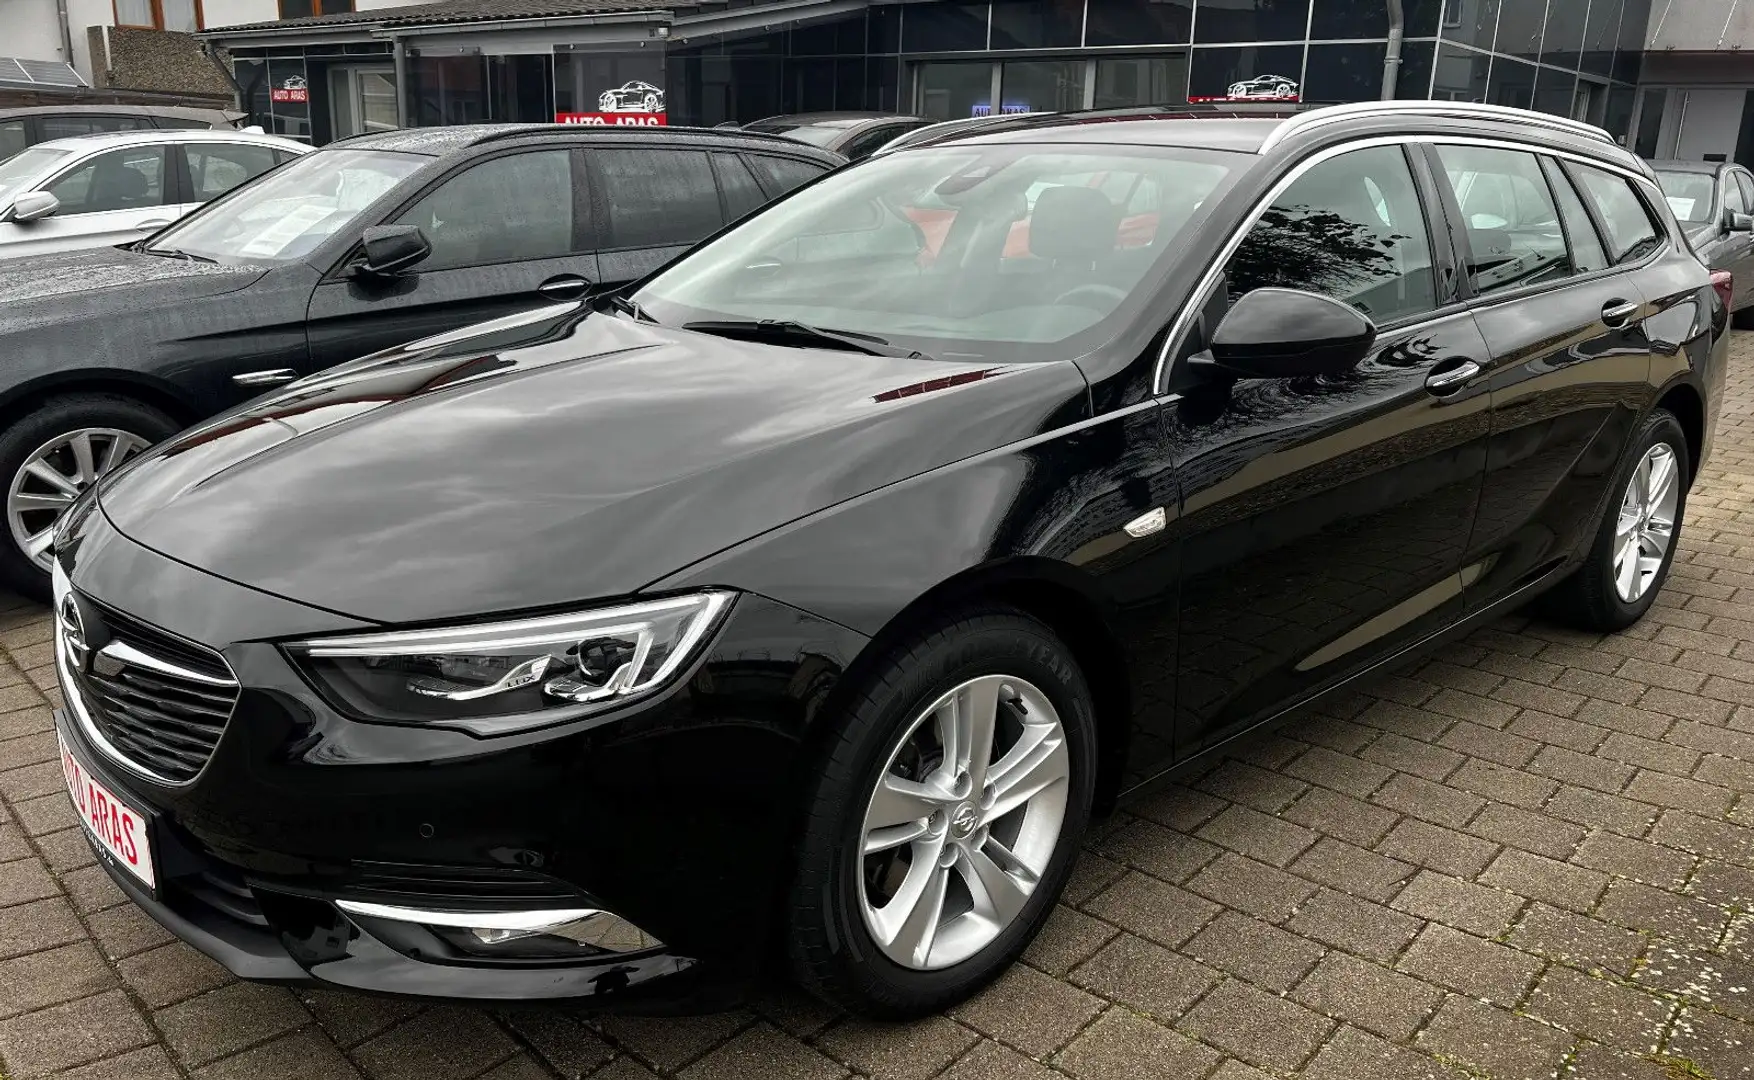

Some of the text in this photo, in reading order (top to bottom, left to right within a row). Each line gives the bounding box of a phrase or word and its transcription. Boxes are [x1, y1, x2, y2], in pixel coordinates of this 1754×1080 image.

[273, 90, 306, 100] AUTO ARAS
[88, 783, 138, 866] ARAS
